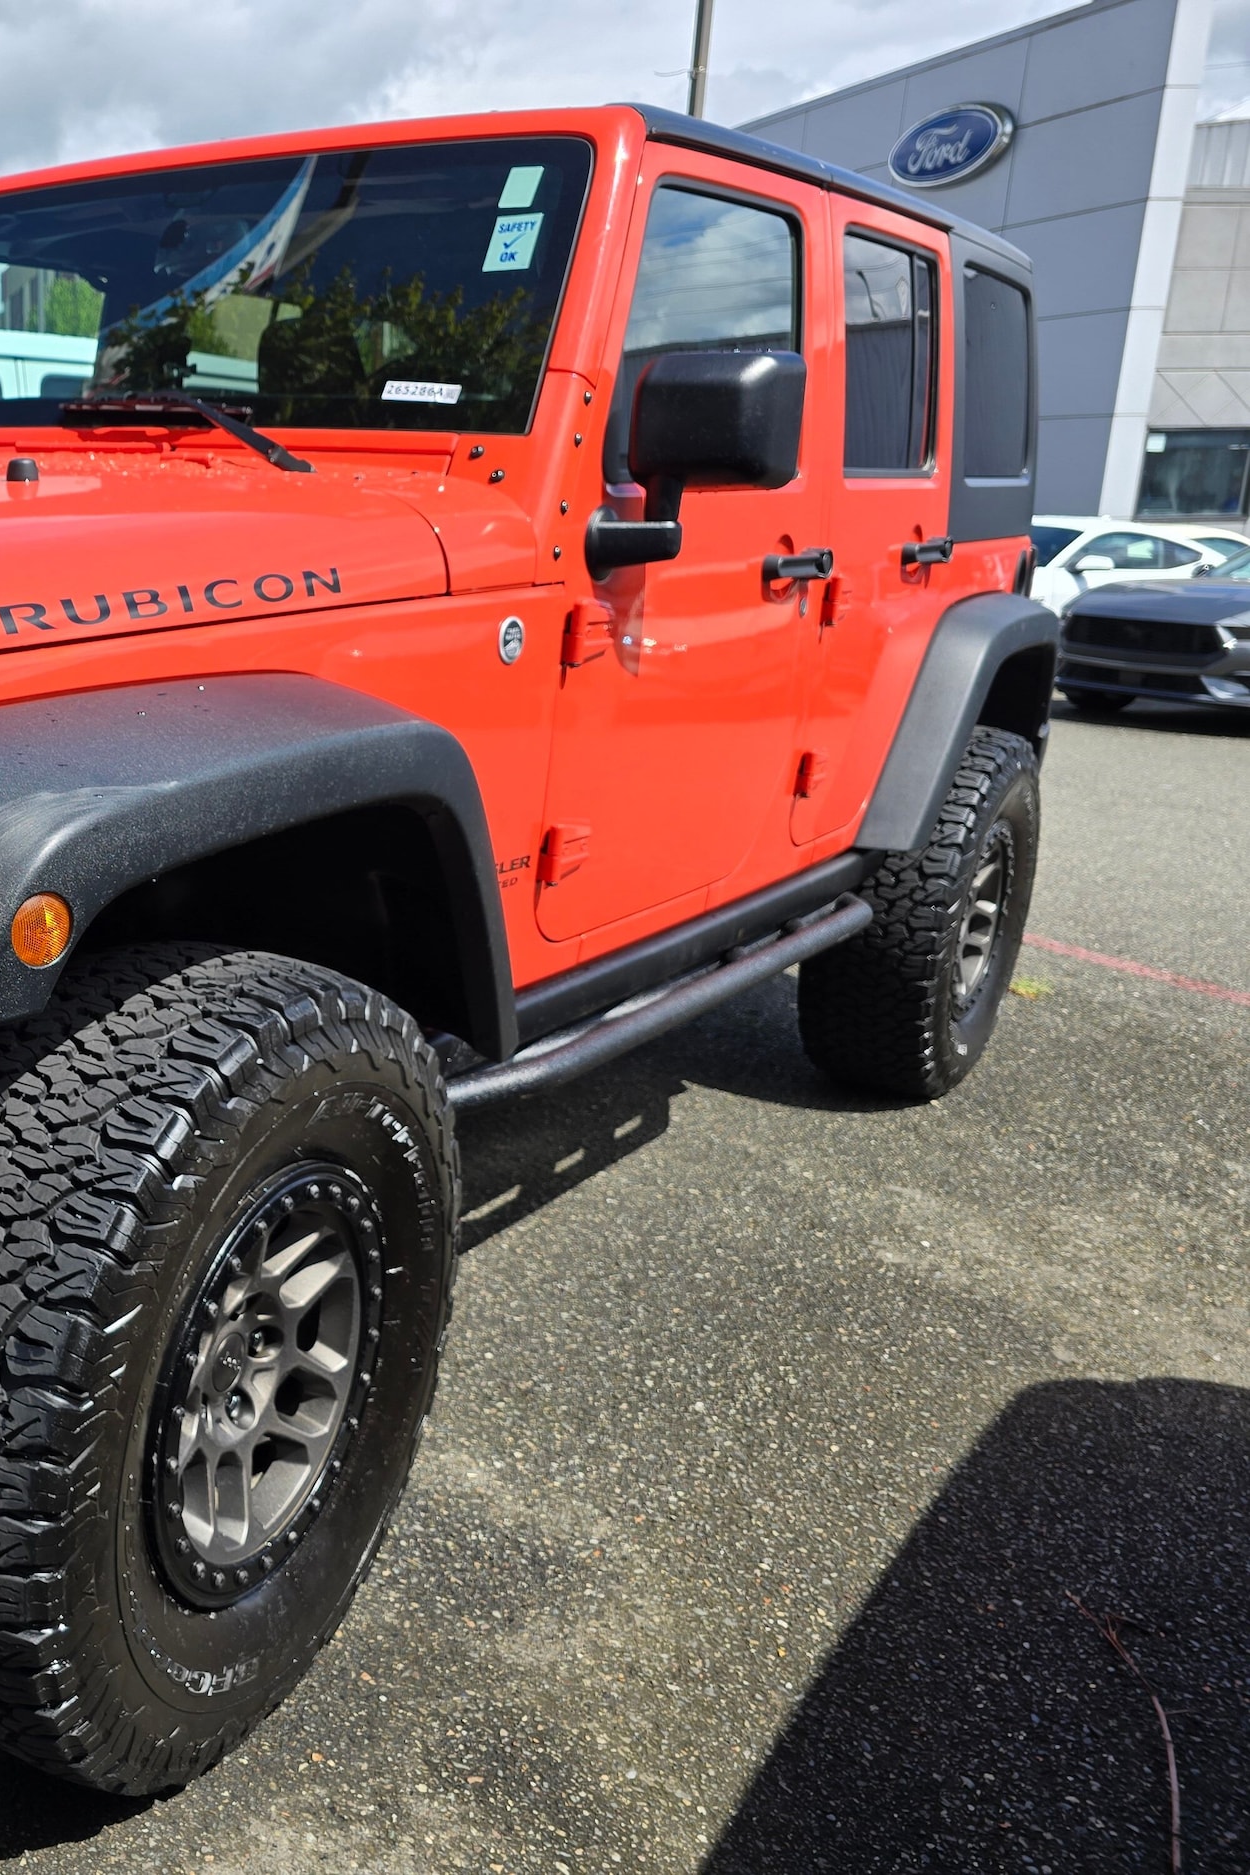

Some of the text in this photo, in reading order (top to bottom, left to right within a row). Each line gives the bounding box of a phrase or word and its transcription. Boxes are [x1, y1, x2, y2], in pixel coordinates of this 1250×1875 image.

[907, 123, 974, 175] Ford
[497, 219, 537, 234] SAFETY
[498, 250, 519, 264] OK
